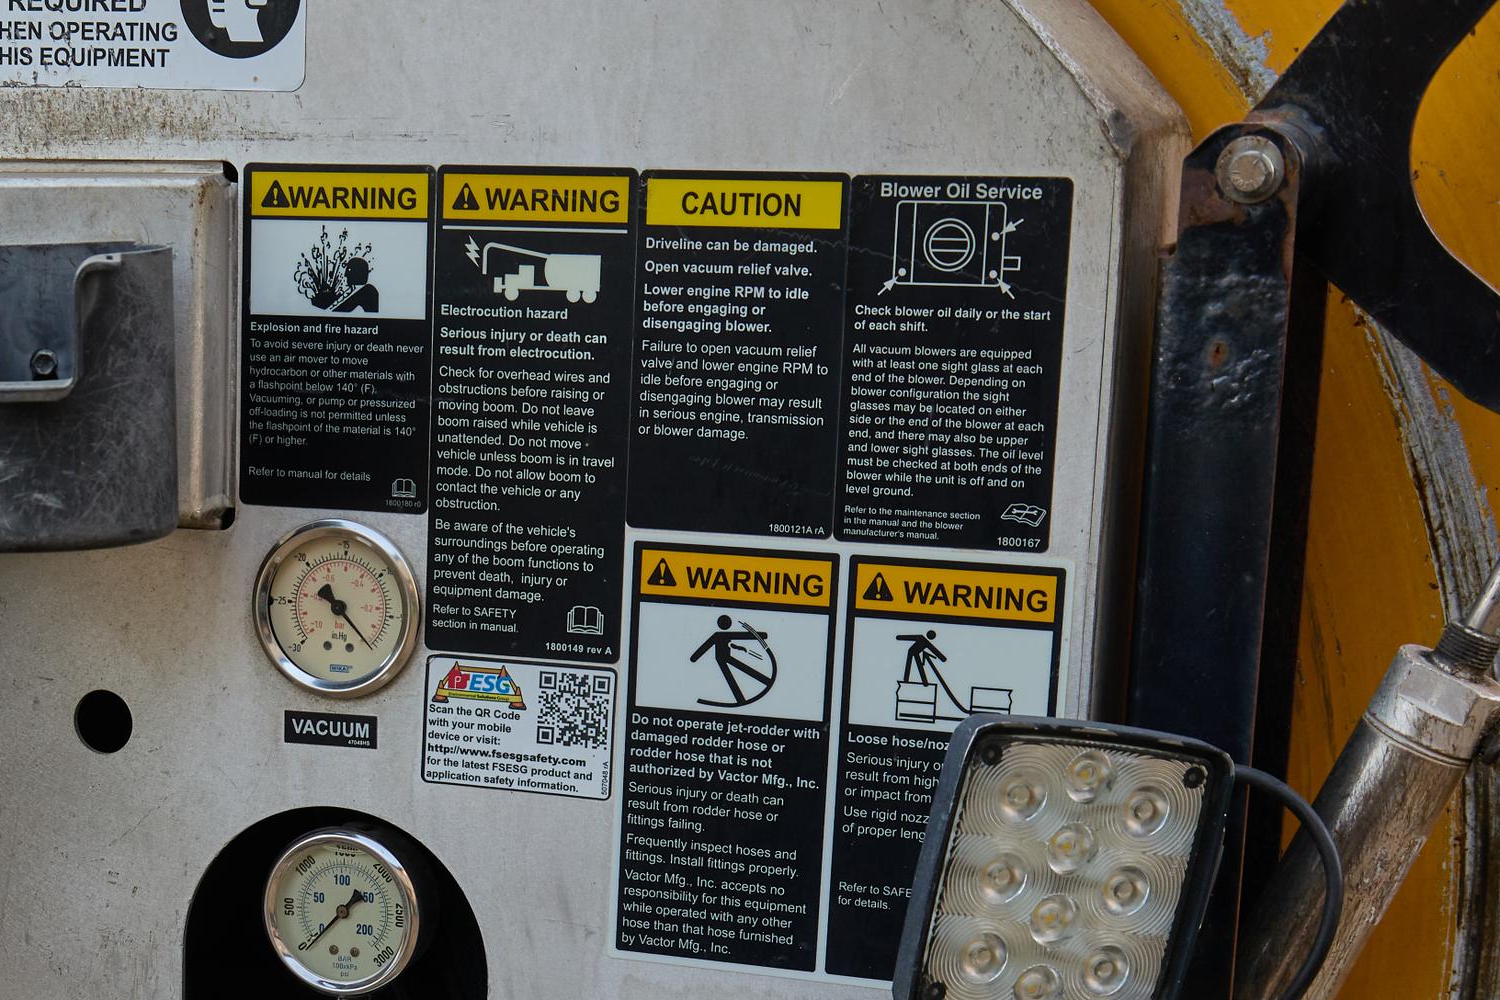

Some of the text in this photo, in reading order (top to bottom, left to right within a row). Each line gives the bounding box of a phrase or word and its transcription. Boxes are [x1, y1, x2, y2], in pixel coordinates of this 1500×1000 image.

[9, 0, 147, 13] REQUIRED
[48, 21, 177, 42] OPERATING
[40, 47, 170, 68] EQUIPMENT
[288, 186, 417, 210] WARNING
[881, 182, 1043, 200] Blower Oil Service
[485, 188, 619, 213] WARNING
[682, 191, 801, 217] CAUTION
[646, 237, 817, 255] Driveline can be damaged.
[441, 304, 568, 319] Electrocution hazard
[250, 321, 378, 335] Explosion and fire hazard
[249, 466, 371, 481] Refer to manual for details
[997, 537, 1041, 548] 1800167
[686, 566, 823, 597] WARNING
[904, 581, 1048, 613] WARNING
[545, 642, 584, 653] 1800149
[605, 647, 612, 655] A
[429, 704, 520, 721] Scan the QR Code
[292, 718, 369, 738] VACUUM
[428, 717, 511, 733] with your mobile
[632, 713, 820, 739] Do not operate jet-rodder with
[428, 730, 460, 741] device
[476, 735, 500, 745] visit:
[427, 743, 586, 767] http://www.fsesgsafety.com
[295, 855, 316, 876] 1000
[334, 874, 350, 886] 100
[313, 892, 325, 903] 50
[284, 898, 294, 916] 500
[356, 923, 373, 936] 200
[373, 945, 394, 967] 3000
